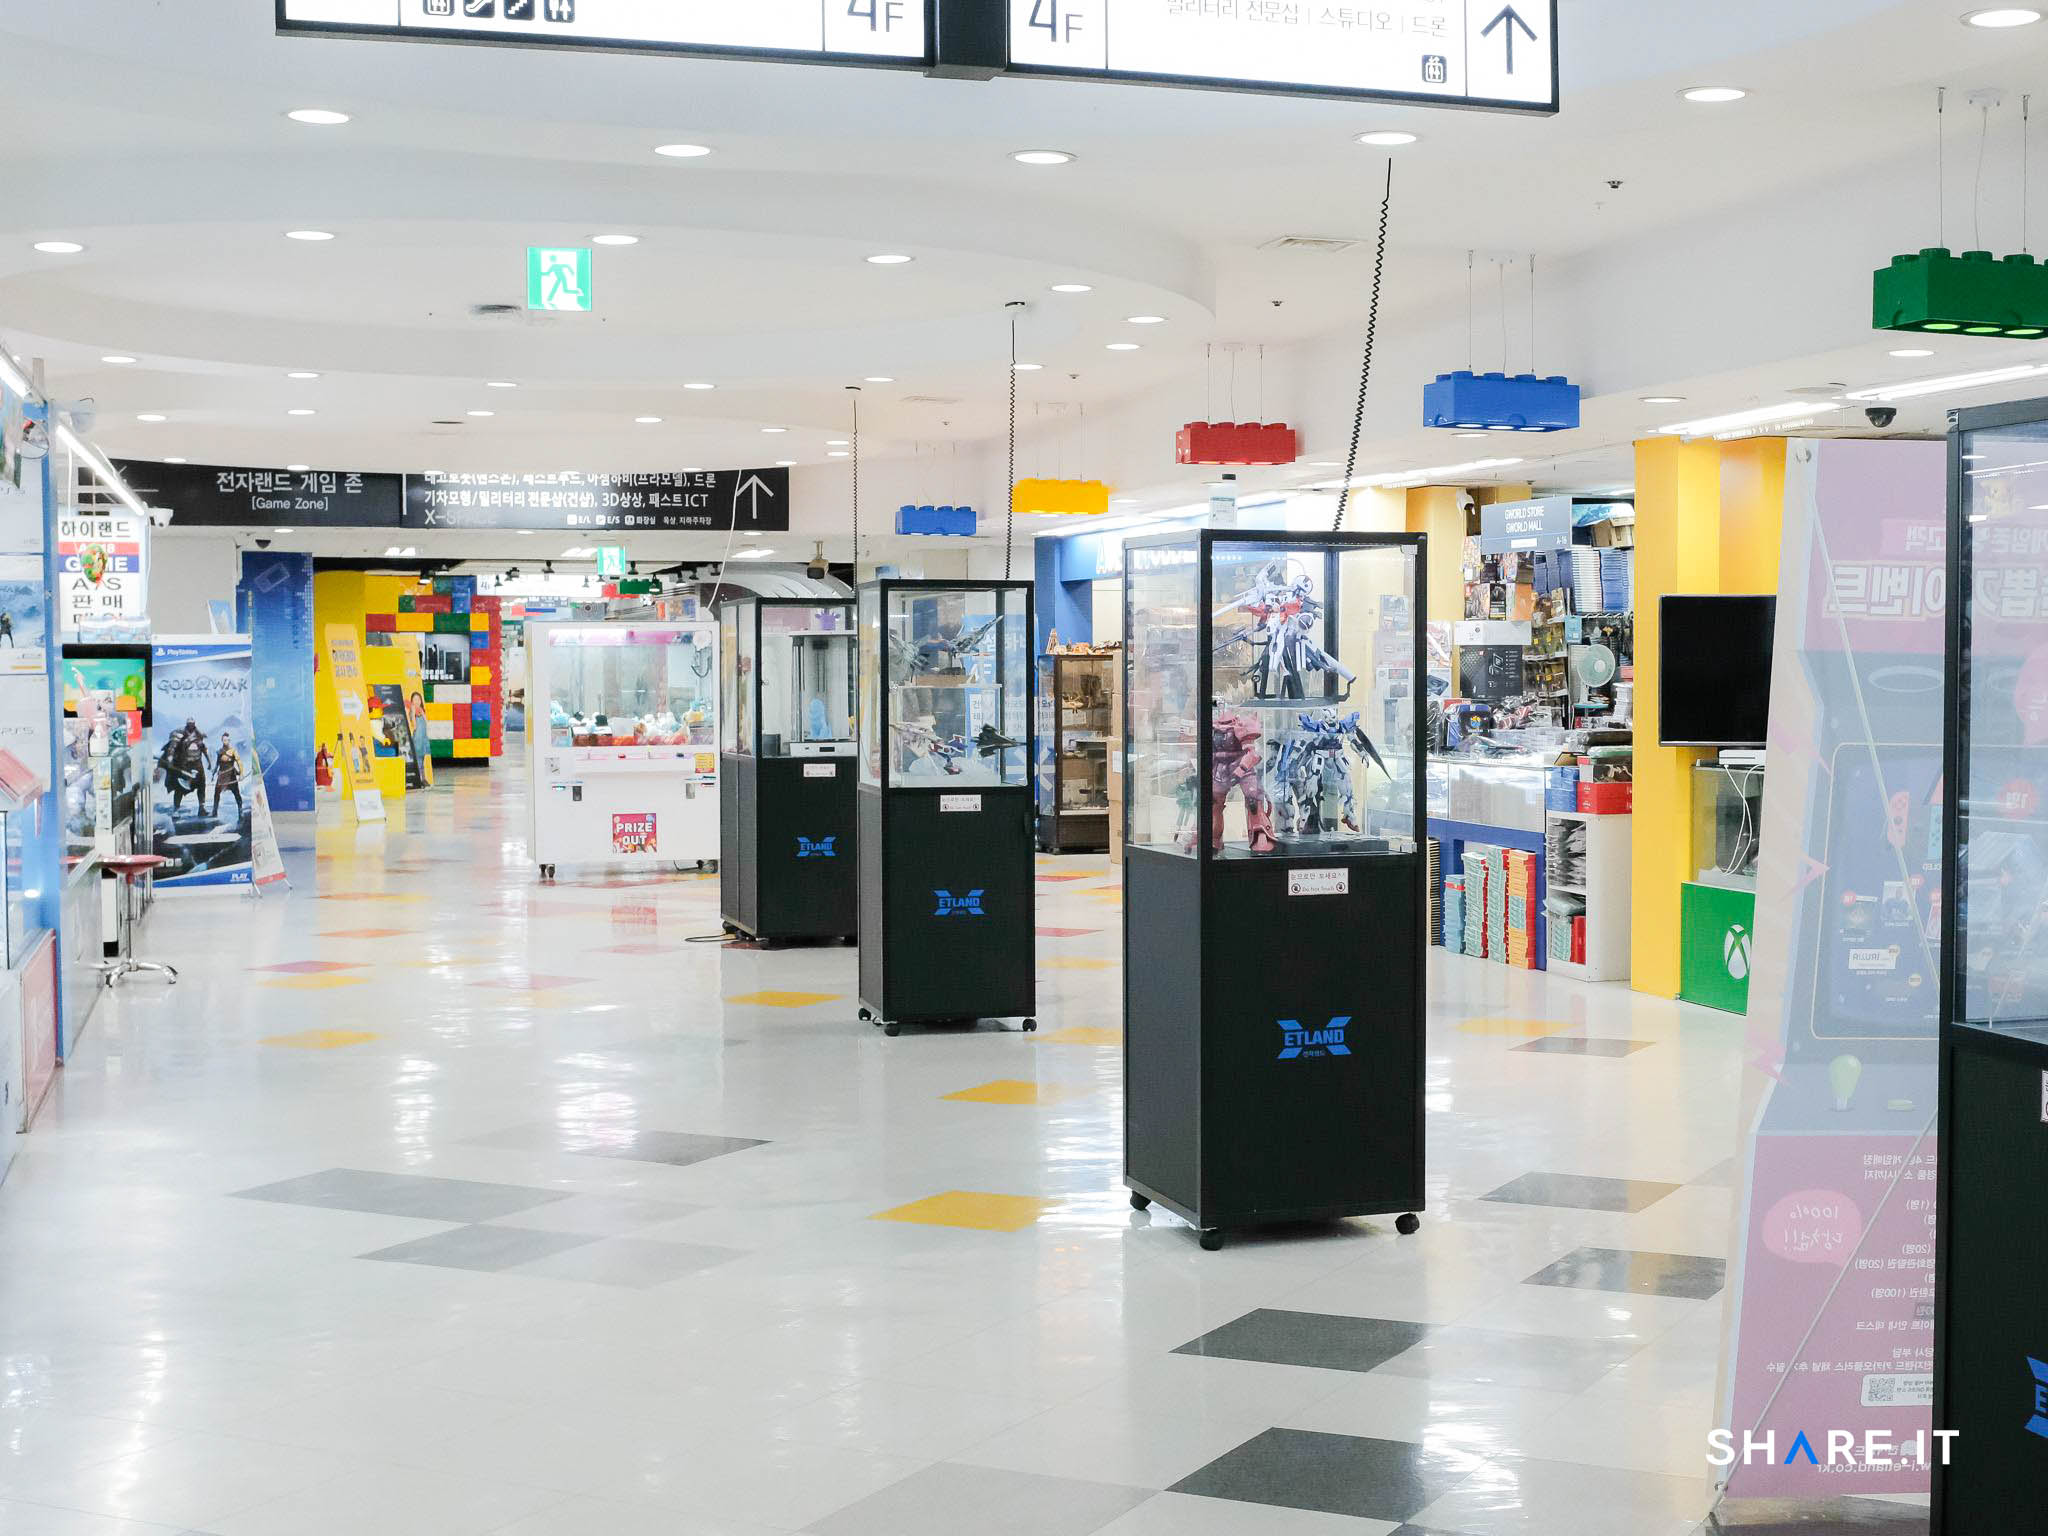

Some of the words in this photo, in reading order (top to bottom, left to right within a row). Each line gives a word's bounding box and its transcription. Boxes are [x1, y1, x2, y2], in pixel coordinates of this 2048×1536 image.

[847, 0, 904, 33] 4F
[1028, 0, 1084, 43] 4F
[1319, 7, 1393, 31] 스튜디오
[1411, 16, 1448, 38] 드론
[216, 472, 293, 493] 전자랜드
[300, 473, 337, 494] 게임
[344, 473, 364, 494] 존
[694, 473, 717, 488] 드론
[251, 496, 291, 511] [Game
[294, 496, 329, 511] Zone]
[601, 491, 646, 508] 3D상상,
[1526, 505, 1545, 518] STORE
[606, 515, 621, 525] E/S
[1528, 519, 1543, 531] MALL
[62, 521, 131, 538] 하이랜드
[616, 822, 654, 833] PRIZE
[622, 835, 648, 845] OUT
[939, 897, 980, 907] ETLAND
[1284, 1029, 1345, 1046] ETLAND
